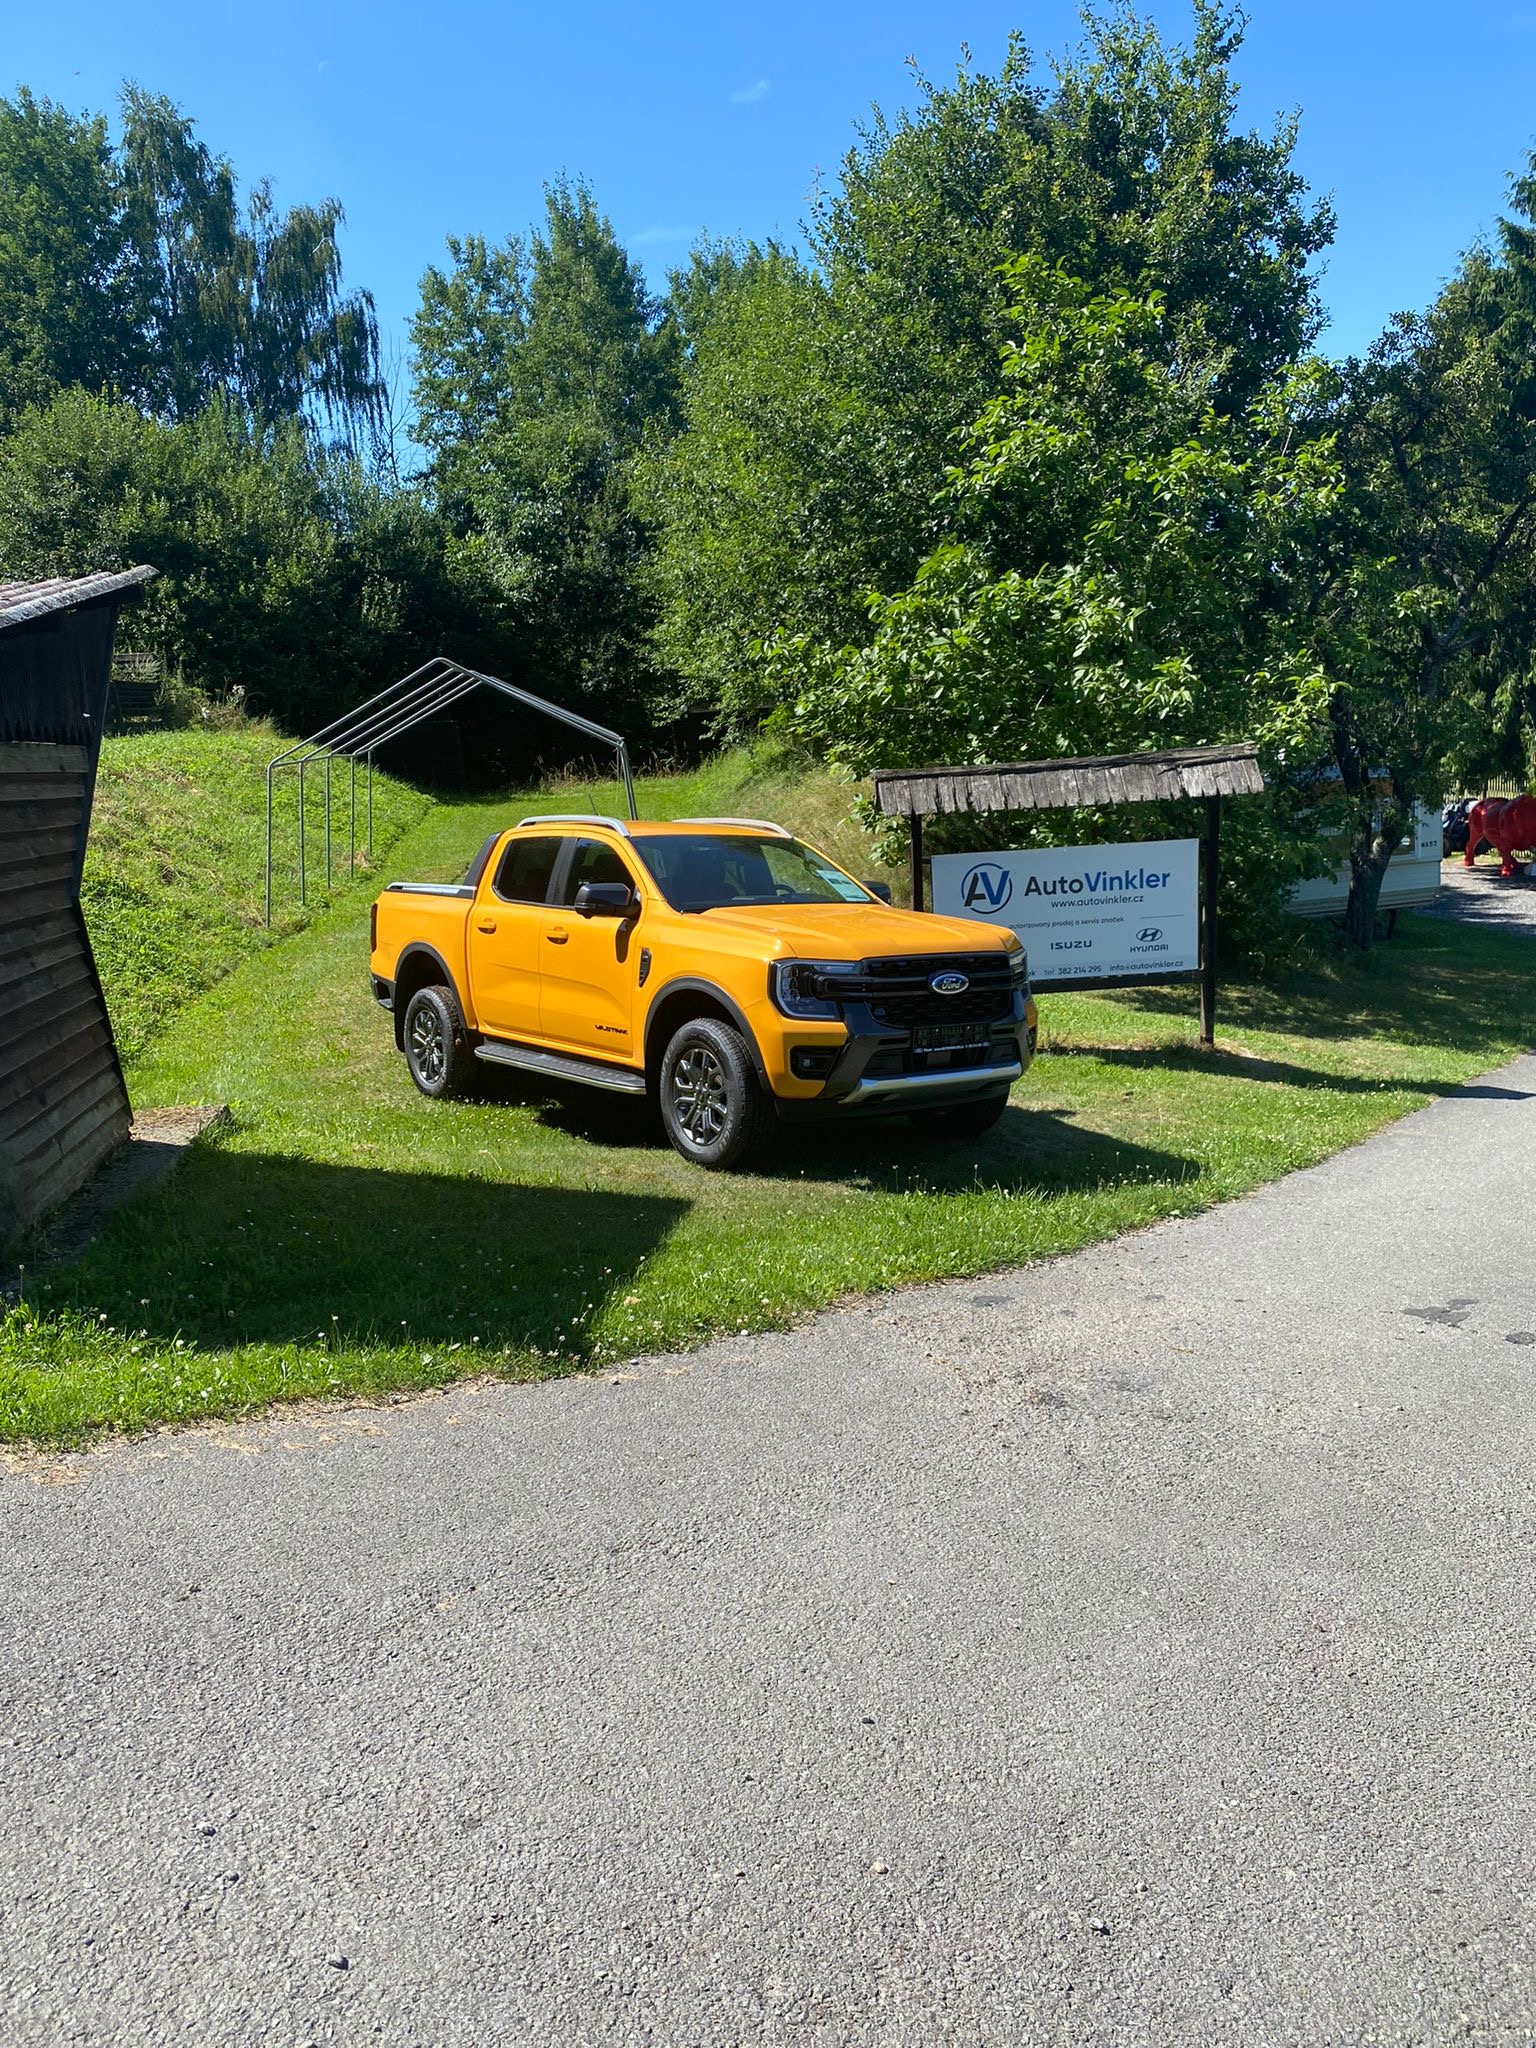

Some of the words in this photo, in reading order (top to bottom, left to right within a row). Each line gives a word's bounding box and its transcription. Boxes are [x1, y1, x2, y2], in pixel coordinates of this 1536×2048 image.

[963, 869, 1010, 907] AV
[1023, 868, 1171, 897] AutoVinkler
[1050, 895, 1145, 908] www.autovinkler.cz
[1052, 919, 1074, 928] prodej
[1081, 917, 1100, 925] servis
[1101, 916, 1124, 924] značek
[1050, 940, 1093, 950] ISUZU
[1129, 944, 1169, 953] HYUNDAI
[1057, 966, 1072, 975] 382
[1073, 966, 1087, 974] 214
[1088, 965, 1103, 973] 295
[941, 977, 962, 990] Ford
